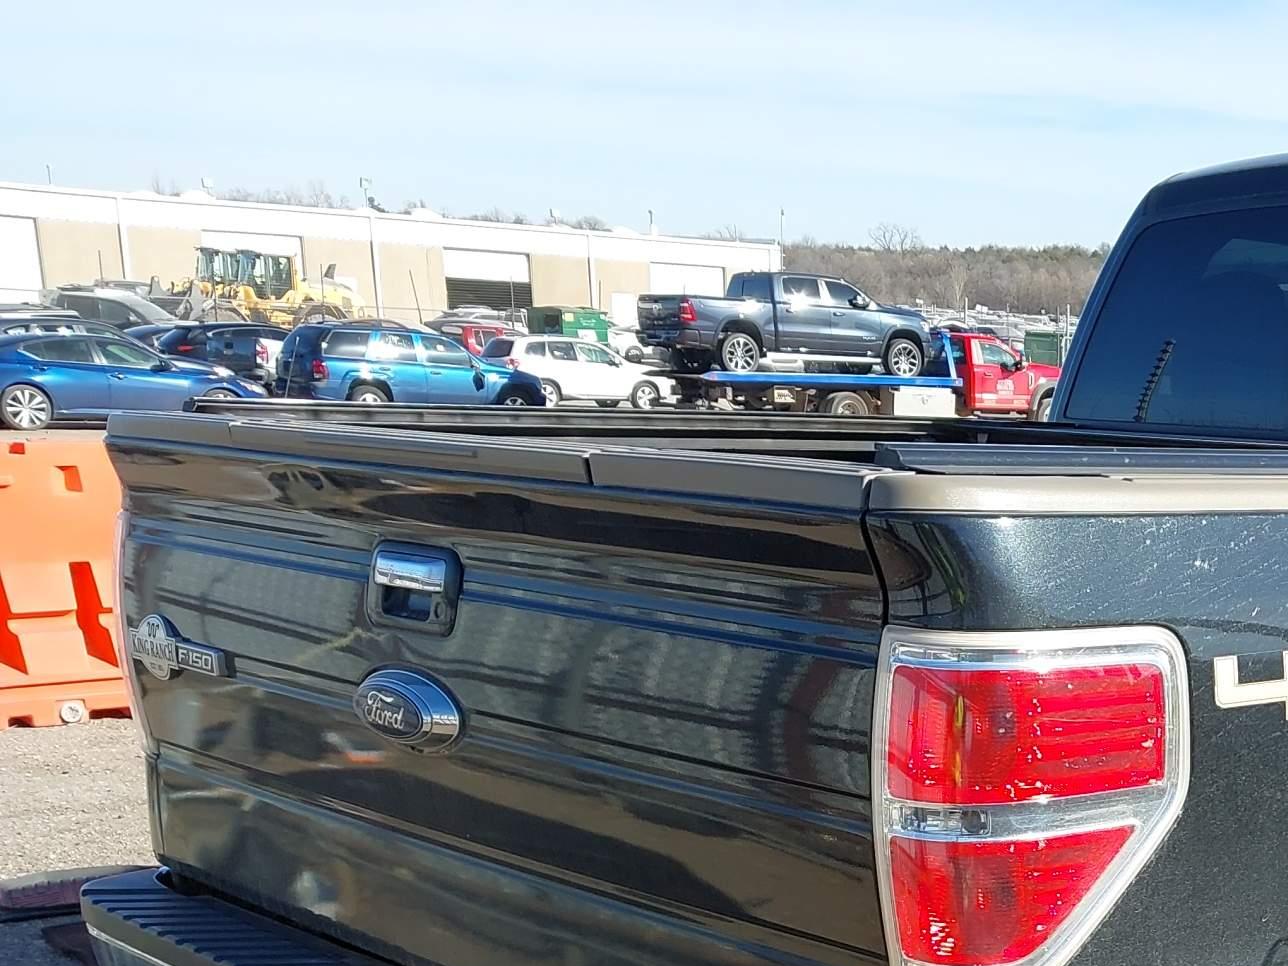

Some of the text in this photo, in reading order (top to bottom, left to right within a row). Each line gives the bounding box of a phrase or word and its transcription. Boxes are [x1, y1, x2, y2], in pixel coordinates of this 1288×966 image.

[132, 633, 174, 662] KING RANCH
[365, 691, 405, 729] Ford
